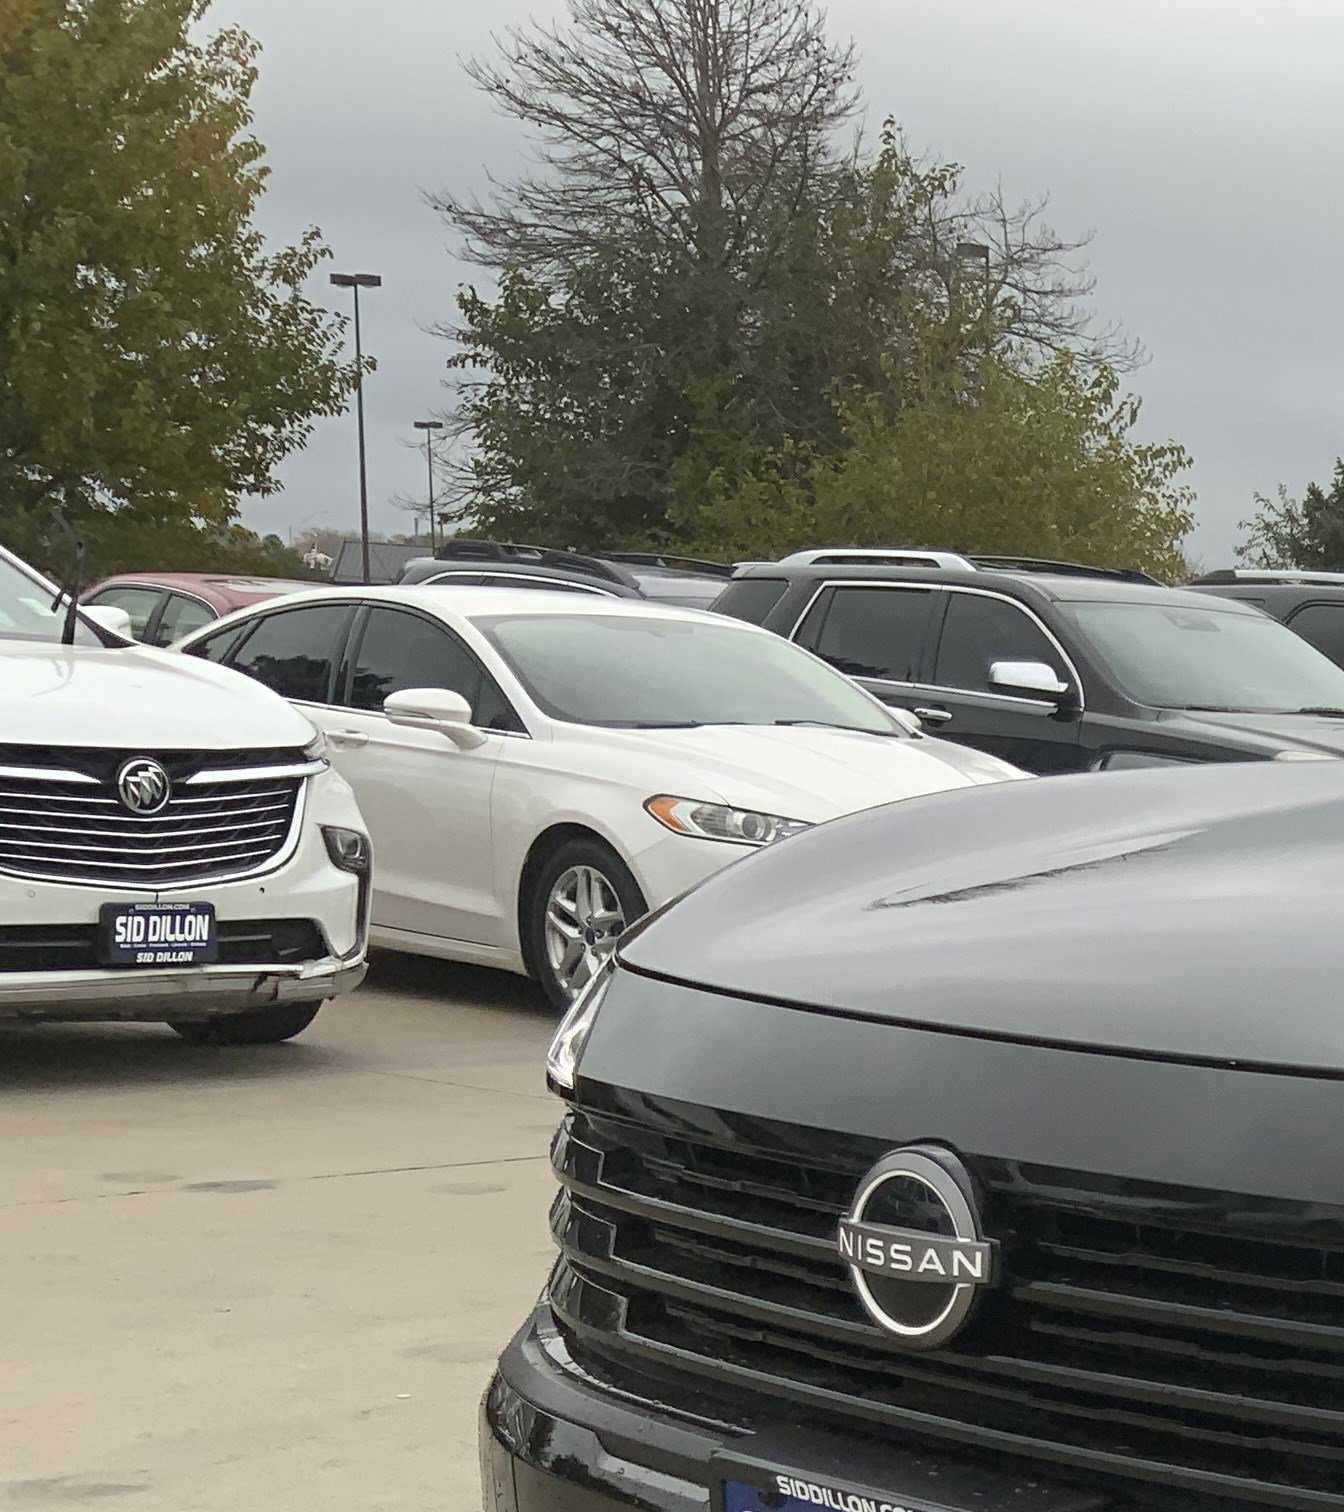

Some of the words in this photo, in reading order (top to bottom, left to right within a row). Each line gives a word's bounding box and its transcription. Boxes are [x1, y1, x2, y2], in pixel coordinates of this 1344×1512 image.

[115, 915, 145, 942] SID
[148, 915, 209, 942] DILLON
[136, 952, 154, 963] SID
[156, 951, 193, 962] DILLON
[839, 1227, 982, 1277] NISSAN
